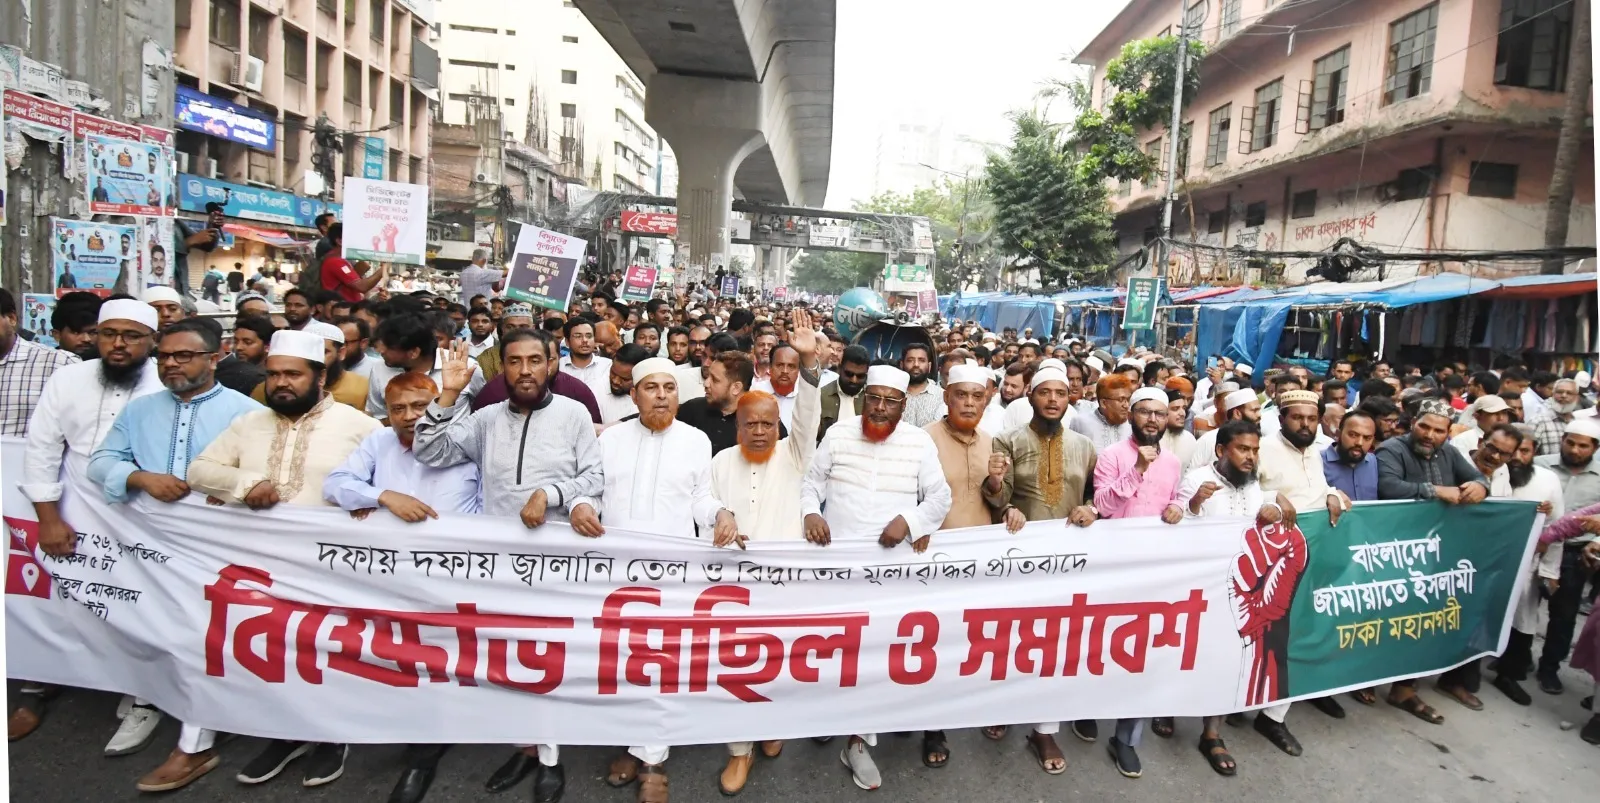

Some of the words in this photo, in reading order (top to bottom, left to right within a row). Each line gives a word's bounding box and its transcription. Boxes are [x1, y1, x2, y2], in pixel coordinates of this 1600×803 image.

[1295, 225, 1316, 241] ঢাকা
[90, 557, 98, 568] ৫
[101, 553, 117, 573] টা
[316, 542, 400, 575] দফায়
[410, 549, 499, 580] দফায়
[508, 550, 616, 587] জ্বালানি
[626, 558, 690, 583] তেল
[702, 562, 724, 583] ও
[985, 548, 1088, 577] প্রতিবাদে
[1348, 534, 1442, 573] বাংলাদেশ
[85, 582, 142, 604] মোকাররম
[1313, 578, 1409, 617] জামায়াতে
[1408, 558, 1477, 604] ইসলামী
[204, 564, 575, 695] বিক্ষোভ
[592, 585, 870, 703] মিছিল
[888, 610, 940, 685] ও
[959, 589, 1209, 681] সমাবেশ
[1336, 618, 1384, 649] ঢাকা
[1388, 597, 1463, 641] মহানগরী
